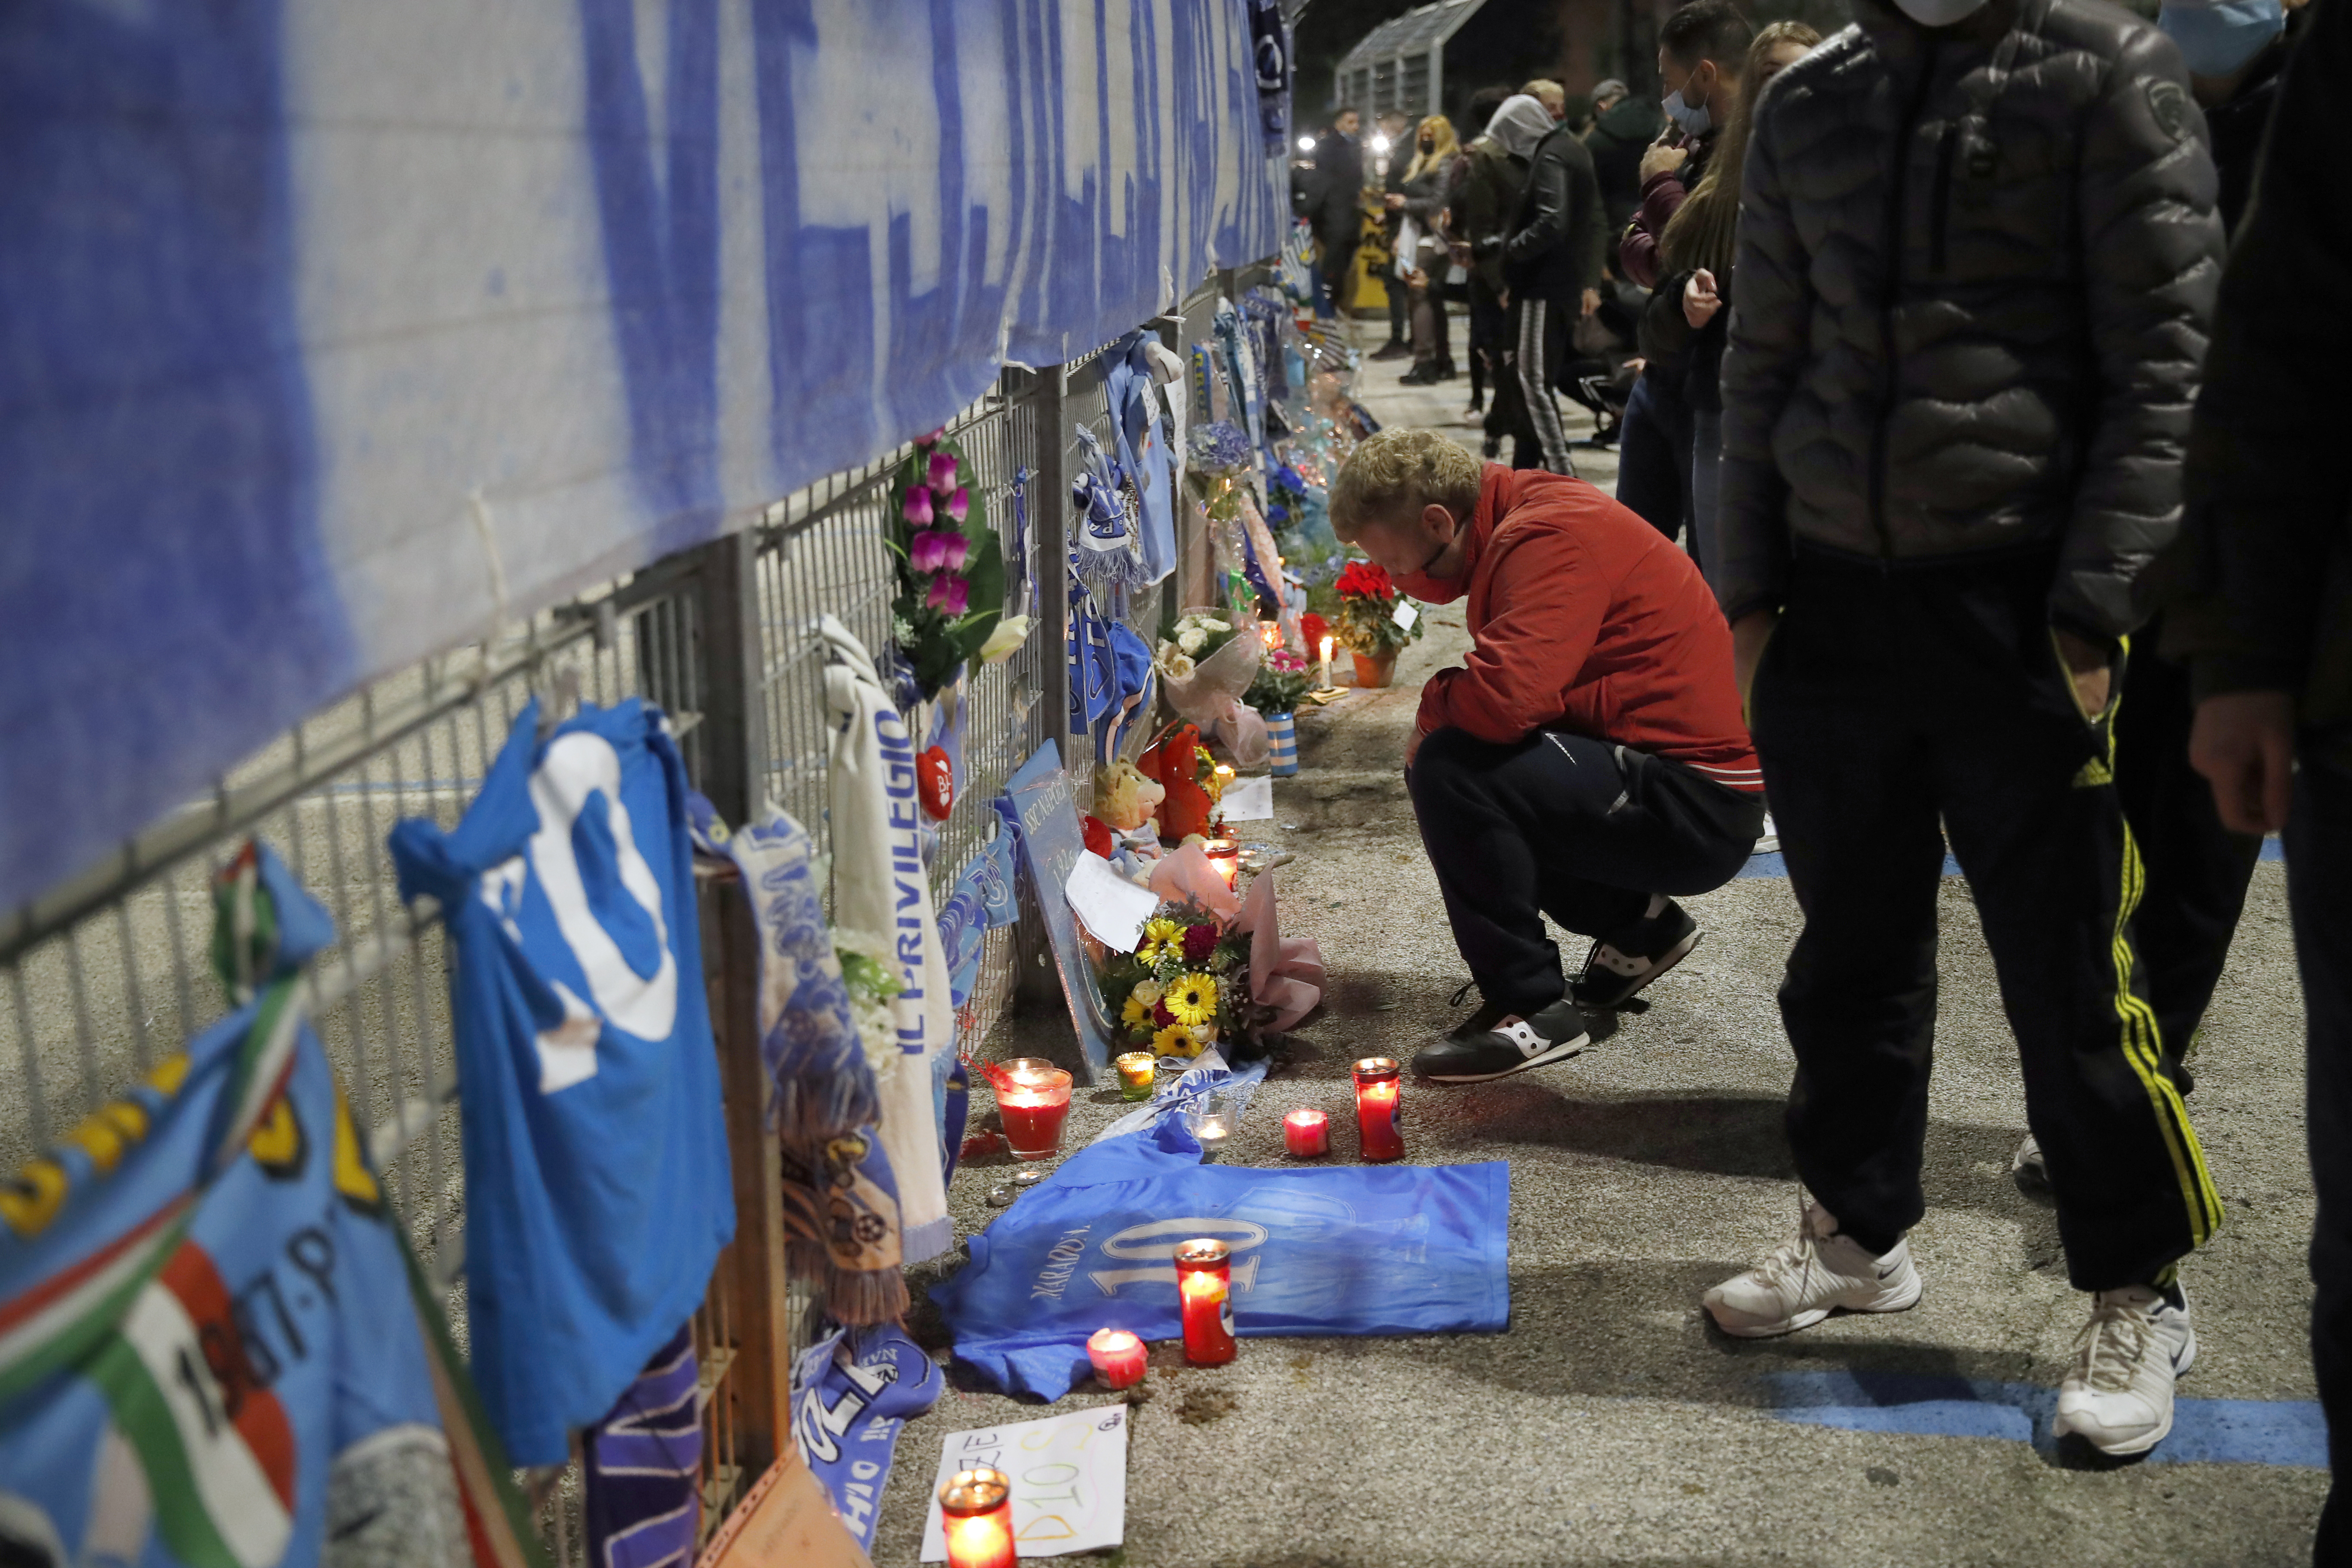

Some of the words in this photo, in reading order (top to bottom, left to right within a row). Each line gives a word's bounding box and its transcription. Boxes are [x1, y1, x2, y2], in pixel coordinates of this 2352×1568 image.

[1023, 803, 1046, 835] SSC
[874, 710, 924, 999] PRIVILEGIO
[1054, 849, 1075, 887] 1926
[896, 1013, 924, 1055] IL
[1087, 1216, 1268, 1295] 10
